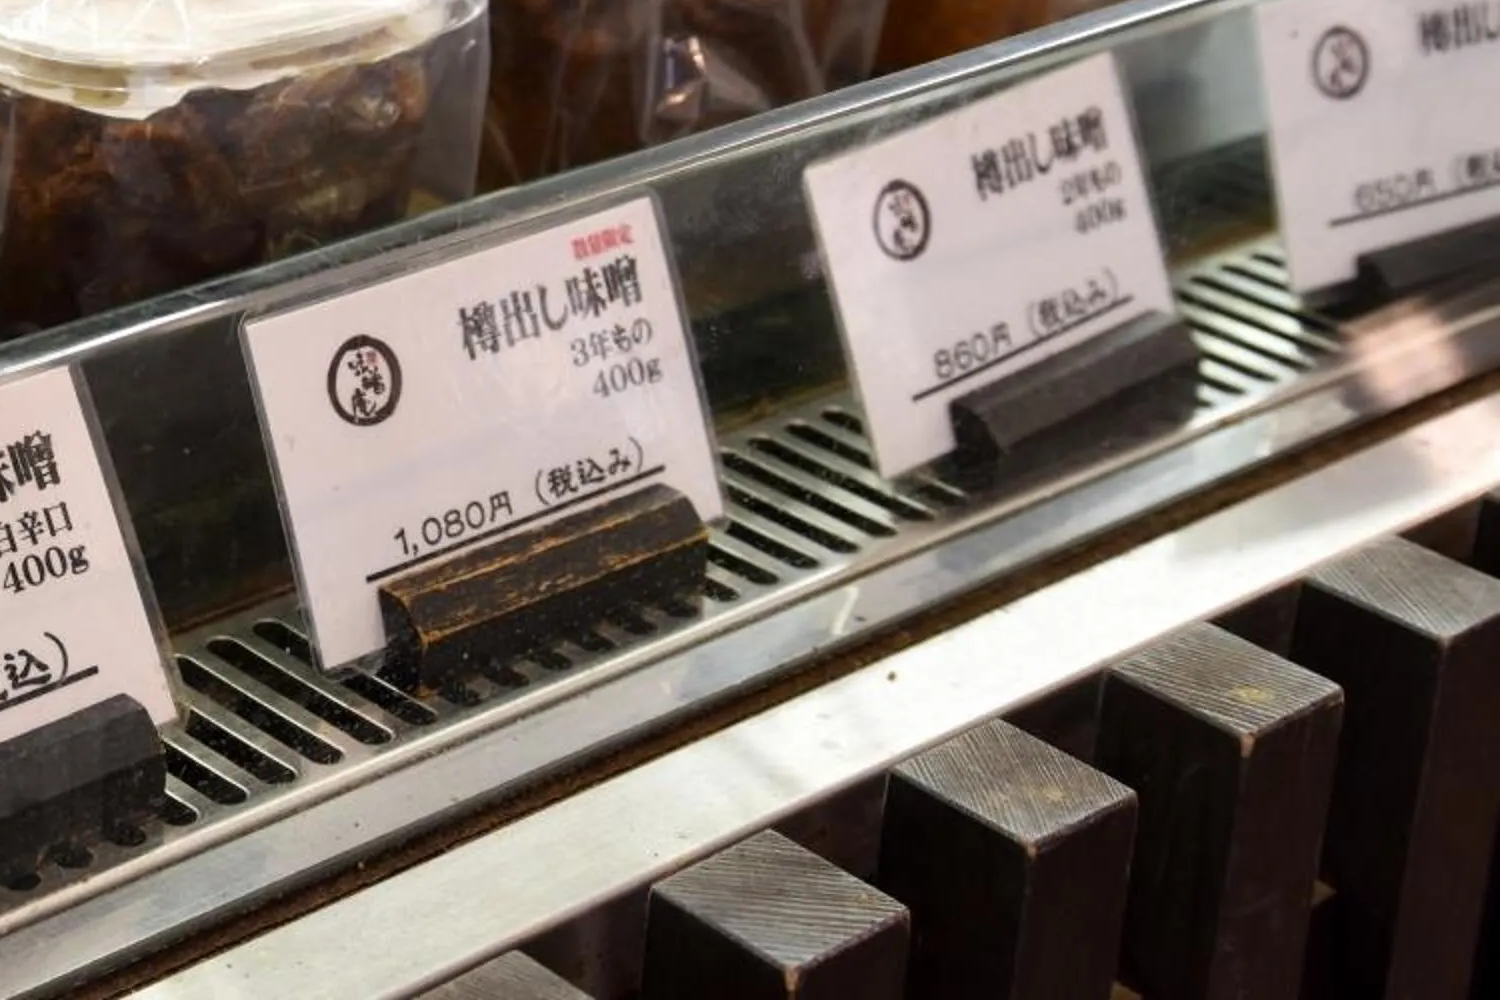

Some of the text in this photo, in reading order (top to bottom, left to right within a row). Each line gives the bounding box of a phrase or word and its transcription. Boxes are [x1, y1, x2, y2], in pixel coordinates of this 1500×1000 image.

[458, 254, 643, 361] 樽出し味噌
[570, 317, 654, 367] 3年もの
[593, 357, 663, 398] 400g
[393, 490, 513, 557] 1,080円
[2, 544, 89, 594] 400g
